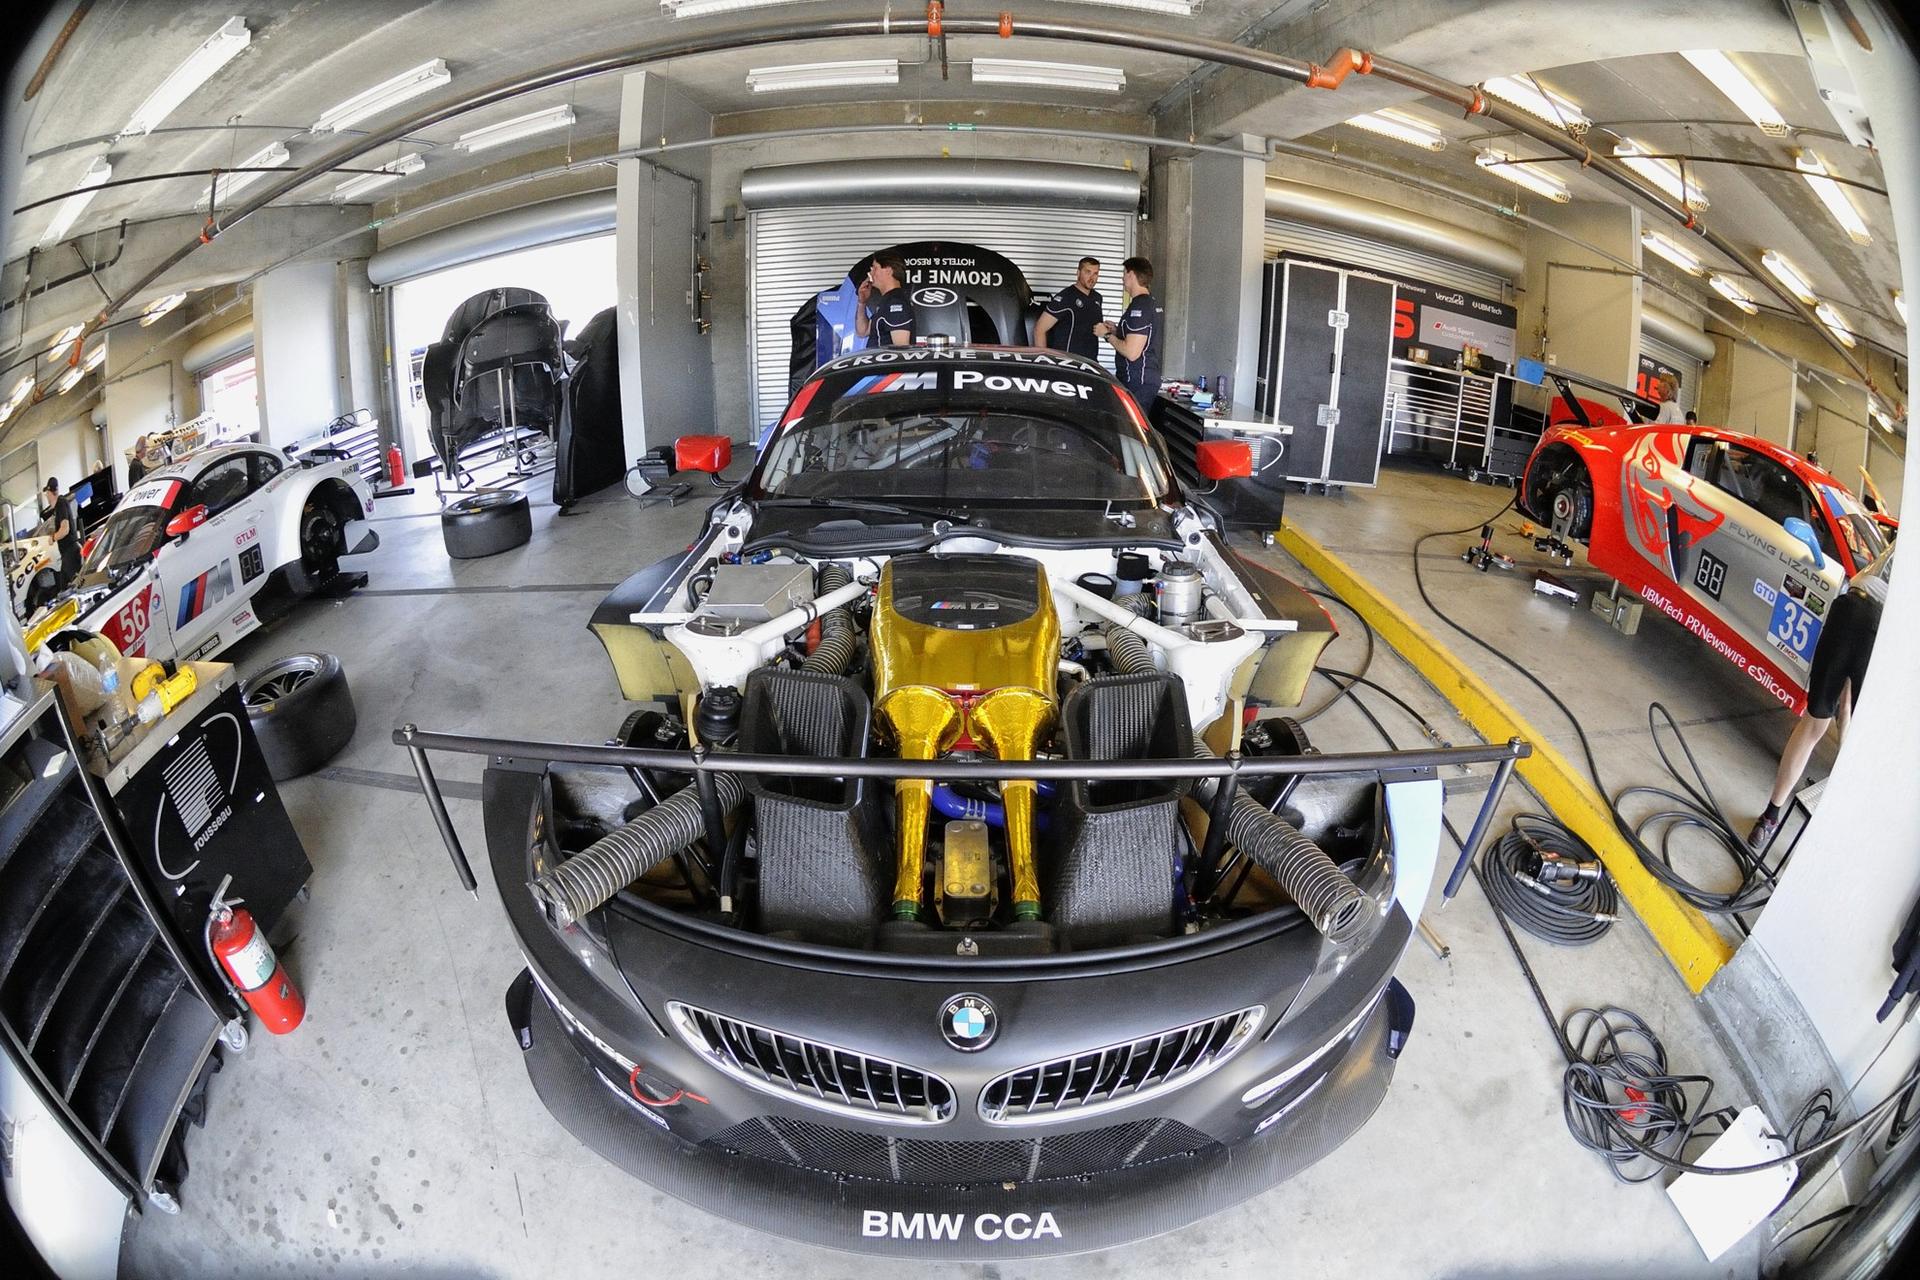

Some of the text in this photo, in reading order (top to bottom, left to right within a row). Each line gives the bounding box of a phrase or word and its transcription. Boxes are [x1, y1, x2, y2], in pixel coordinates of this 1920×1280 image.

[904, 258, 932, 266] RESOR
[942, 258, 975, 266] HOTELS
[929, 269, 1003, 286] CROWNE
[831, 351, 1101, 375] CROWNE PLAZA
[953, 370, 1094, 400] Power
[235, 527, 257, 546] GTLM
[1729, 522, 1777, 555] FLYING
[1779, 552, 1830, 592] LIZARD
[1755, 582, 1776, 602] GTD
[119, 598, 146, 644] 56
[1778, 602, 1813, 652] 35
[1747, 664, 1796, 710] eSilicon
[193, 805, 233, 851] rousseau
[948, 999, 992, 1017] BMW
[862, 1209, 1063, 1241] BMW CCA
